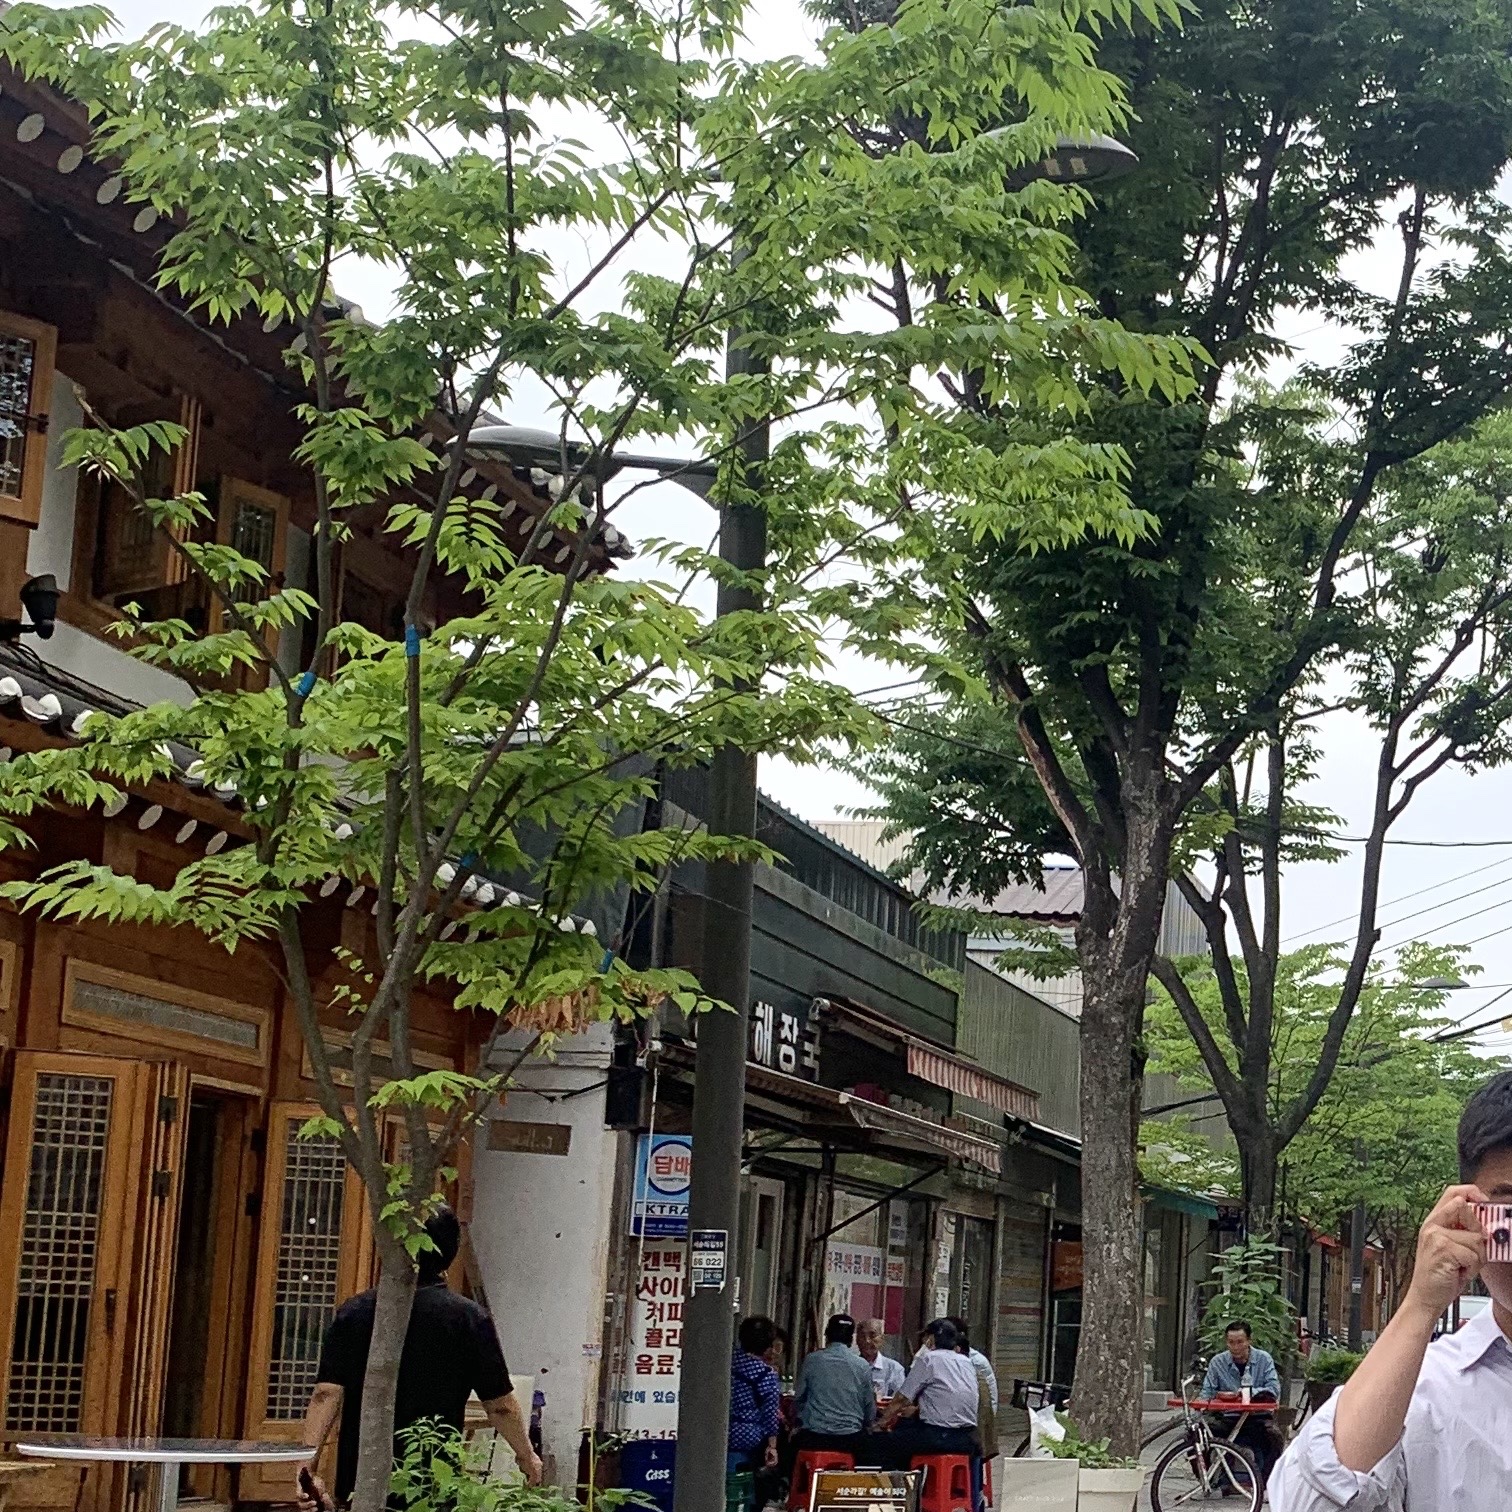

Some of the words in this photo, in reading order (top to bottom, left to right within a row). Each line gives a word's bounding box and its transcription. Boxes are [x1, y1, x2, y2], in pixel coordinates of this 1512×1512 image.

[641, 1251, 686, 1273] 캔맥
[641, 1276, 686, 1298] 사이
[645, 1301, 683, 1323] 커피
[635, 1354, 681, 1376] 음료
[653, 1390, 678, 1404] 있습
